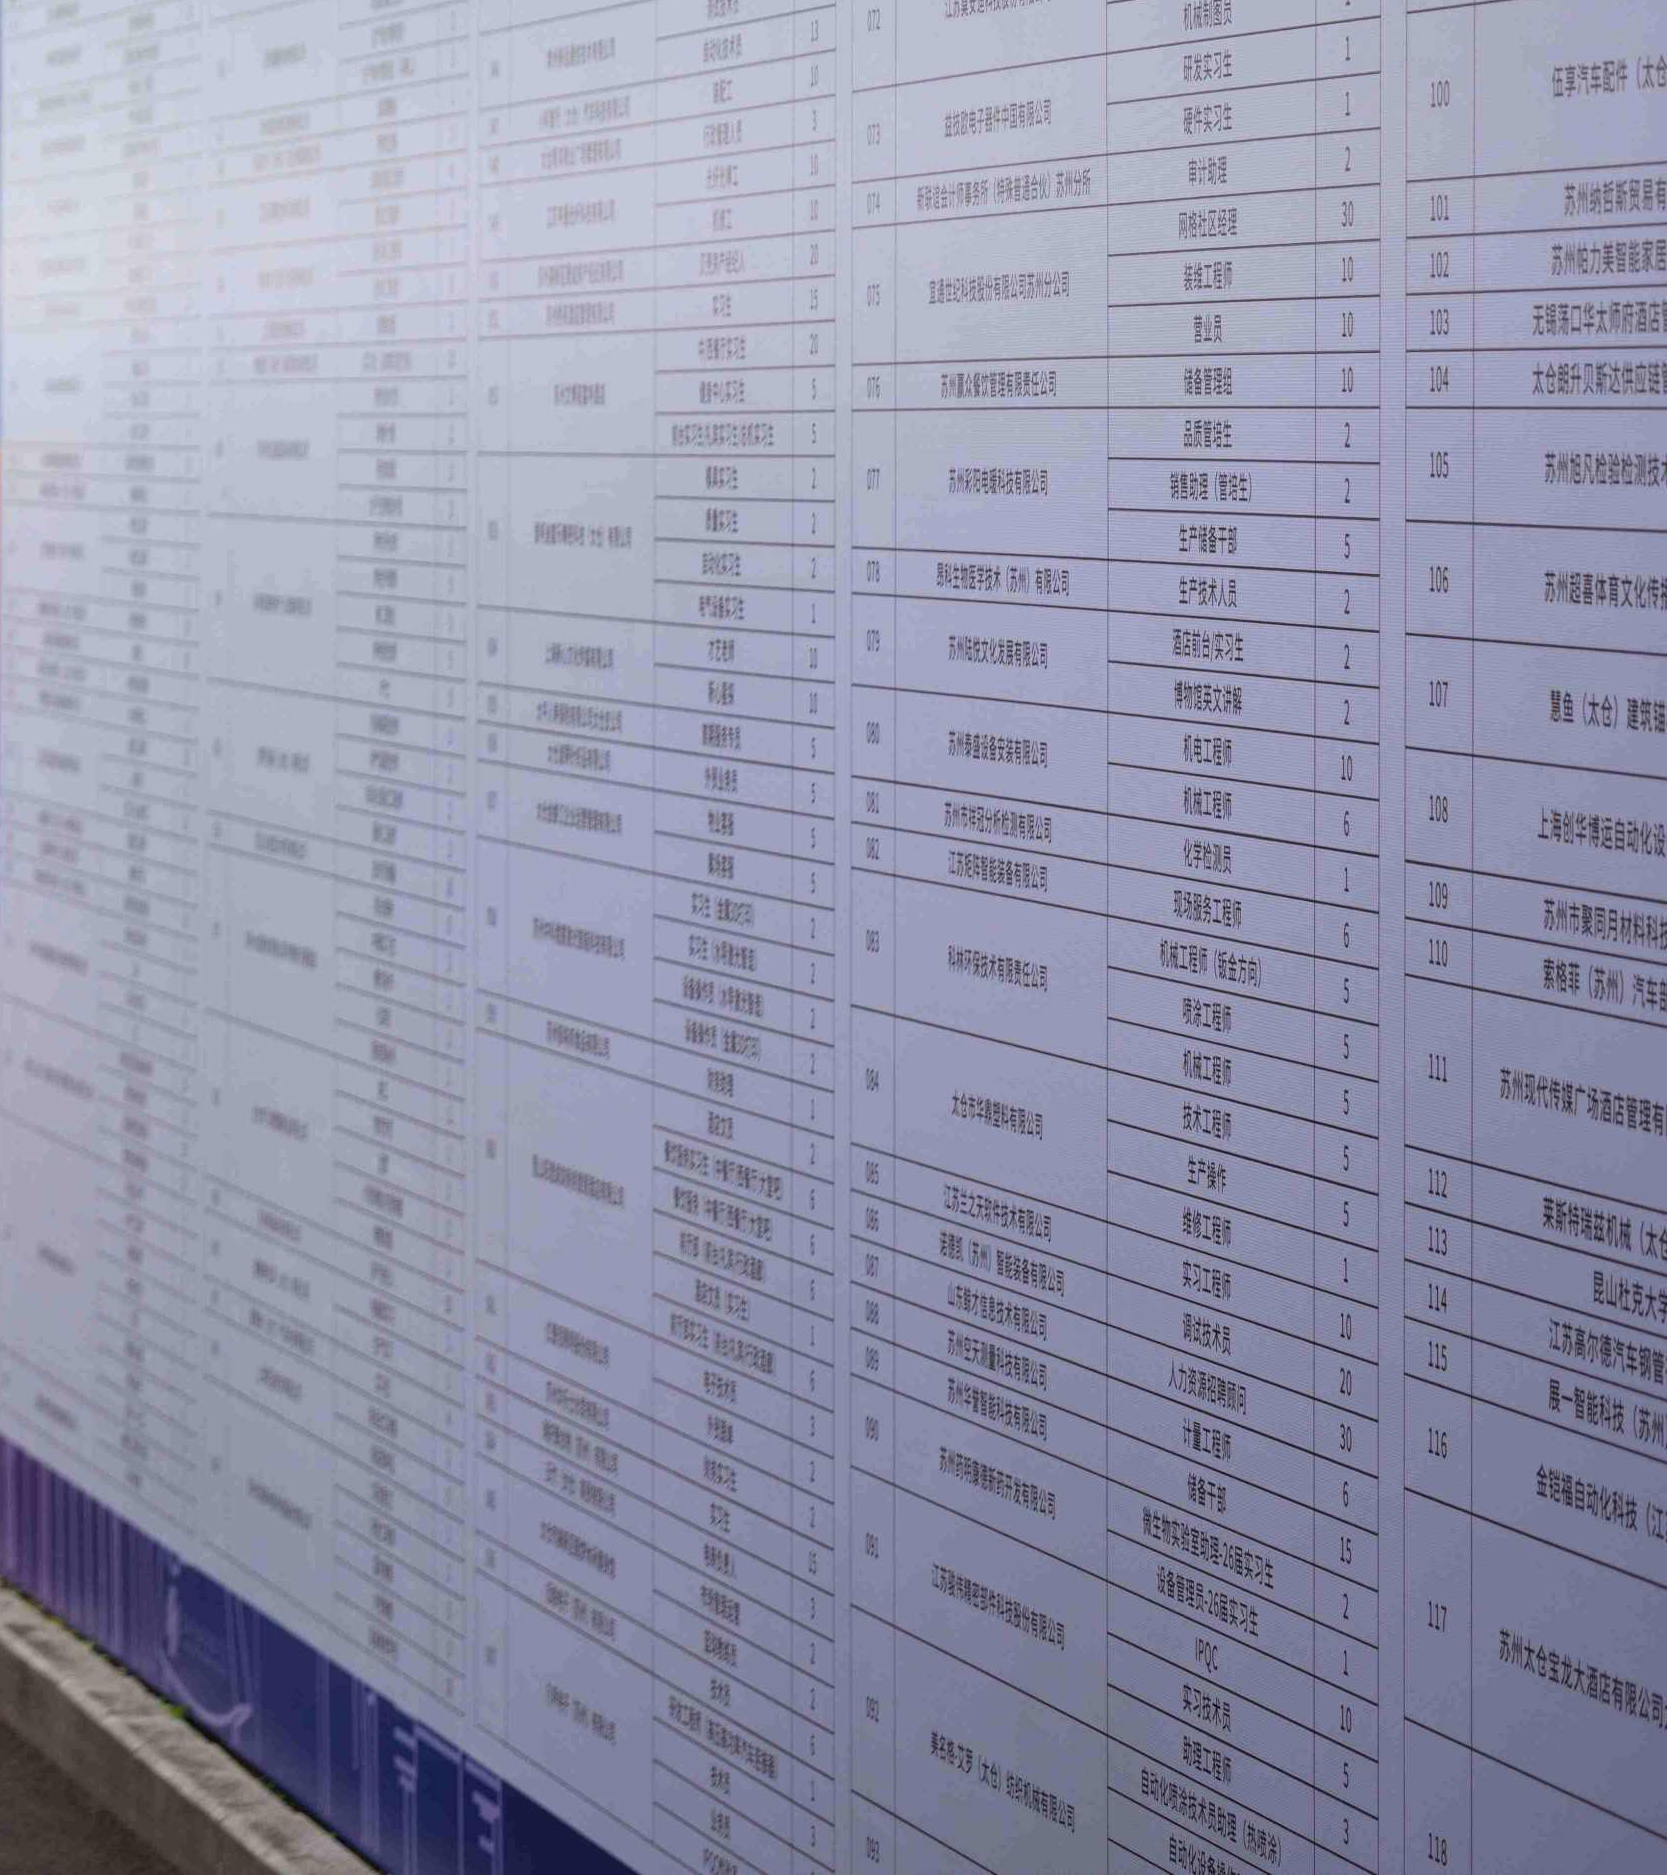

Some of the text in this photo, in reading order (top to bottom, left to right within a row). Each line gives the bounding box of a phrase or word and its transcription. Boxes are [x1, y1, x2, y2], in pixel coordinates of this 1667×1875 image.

[1183, 50, 1233, 82] 研发实习生
[1430, 79, 1450, 108] 100
[1183, 103, 1233, 135] 硬件实习生
[1188, 155, 1228, 186] 审计助理
[1178, 207, 1238, 240] 网格社区经理
[1341, 200, 1354, 228] 30
[1430, 194, 1450, 222] 101
[1183, 261, 1233, 291] 装维工程师
[1341, 256, 1354, 283] 10
[1430, 251, 1450, 279] 102
[1193, 314, 1223, 344] 营业员
[1341, 311, 1354, 338] 10
[1429, 308, 1450, 336] 103
[1183, 367, 1233, 396] 储备管理组
[1341, 366, 1354, 394] 10
[1429, 365, 1449, 393] 104
[1183, 419, 1233, 449] 品质管培生
[1429, 451, 1449, 479] 105
[1178, 525, 1238, 554] 生产储备干部
[1179, 576, 1237, 608] 生产技术人员
[1429, 565, 1449, 594] 106
[1172, 628, 1244, 662] 酒店前台/实习生
[1173, 680, 1242, 715] 博物馆英文讲解
[1429, 680, 1449, 708] 107
[1183, 734, 1232, 767] 机电工程师
[1340, 754, 1353, 782] 10
[1183, 786, 1233, 820] 机械工程师
[1429, 794, 1449, 824] 108
[1183, 838, 1232, 874] 化学检测员
[1173, 889, 1242, 928] 现场服务工程师
[1428, 880, 1449, 910] 109
[1428, 938, 1448, 968] 110
[1182, 997, 1232, 1033] 喷涂工程师
[1183, 1049, 1232, 1086] 机械工程师
[1428, 1053, 1448, 1083] 111
[1182, 1104, 1232, 1139] 技术工程师
[1500, 1068, 1667, 1147] 苏州现代传媒广场酒店管理有
[1187, 1157, 1227, 1192] 生产操作
[1428, 1167, 1448, 1199] 112
[1182, 1207, 1232, 1246] 维修工程师
[1428, 1225, 1448, 1257] 113
[1182, 1260, 1231, 1299] 实习工程师
[1428, 1283, 1447, 1312] 114
[1182, 1312, 1231, 1356] 调试技术员
[1340, 1312, 1352, 1341] 10
[1428, 1340, 1448, 1372] 115
[1549, 1318, 1667, 1396] 江苏高尔德汽车钢管
[1168, 1365, 1246, 1416] 人力资源招聘顾问
[1339, 1367, 1352, 1397] 20
[1182, 1421, 1231, 1460] 计量工程师
[1339, 1423, 1353, 1453] 30
[1428, 1427, 1448, 1460] 116
[1187, 1473, 1227, 1514] 储备干部
[1536, 1464, 1667, 1552] 金铠福自动化科技（江
[1339, 1536, 1352, 1565] 15
[1427, 1600, 1447, 1632] 117
[1195, 1637, 1219, 1674] IPQC
[1499, 1629, 1667, 1740] 苏州太仓宝龙大酒店有限公司
[1182, 1684, 1231, 1732] 实习技术员
[1340, 1704, 1352, 1734] 10
[1182, 1735, 1232, 1783] 助理工程师
[1427, 1832, 1449, 1867] 118
